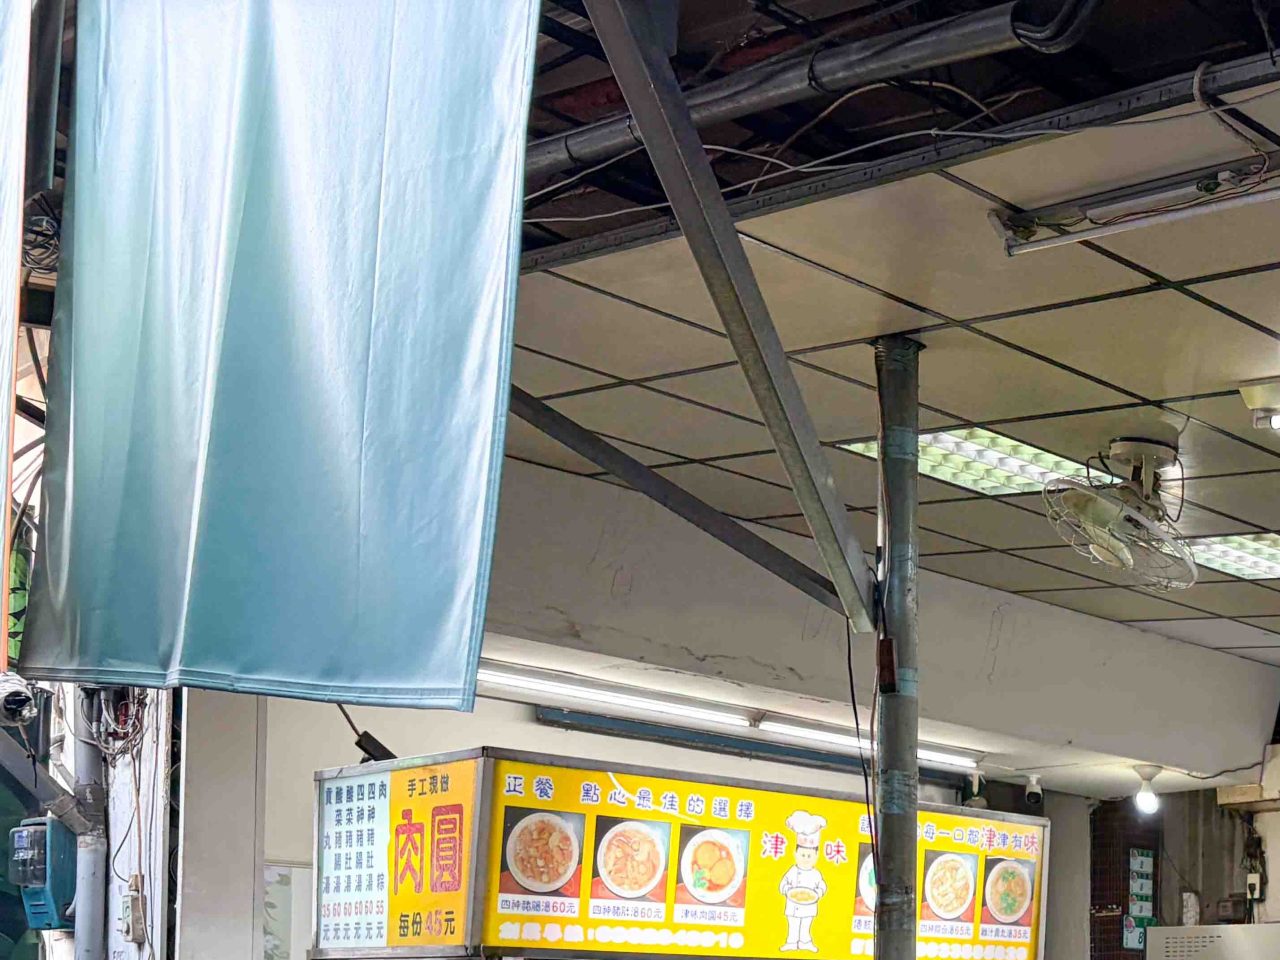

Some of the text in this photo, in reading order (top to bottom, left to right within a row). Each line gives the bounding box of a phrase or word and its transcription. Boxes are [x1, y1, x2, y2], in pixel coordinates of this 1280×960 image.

[408, 774, 450, 798] 手工現做
[505, 775, 554, 799] 正餐
[394, 803, 464, 896] 肉圓
[762, 832, 848, 864] 津 味
[917, 823, 1040, 855] 每一口都津津有味
